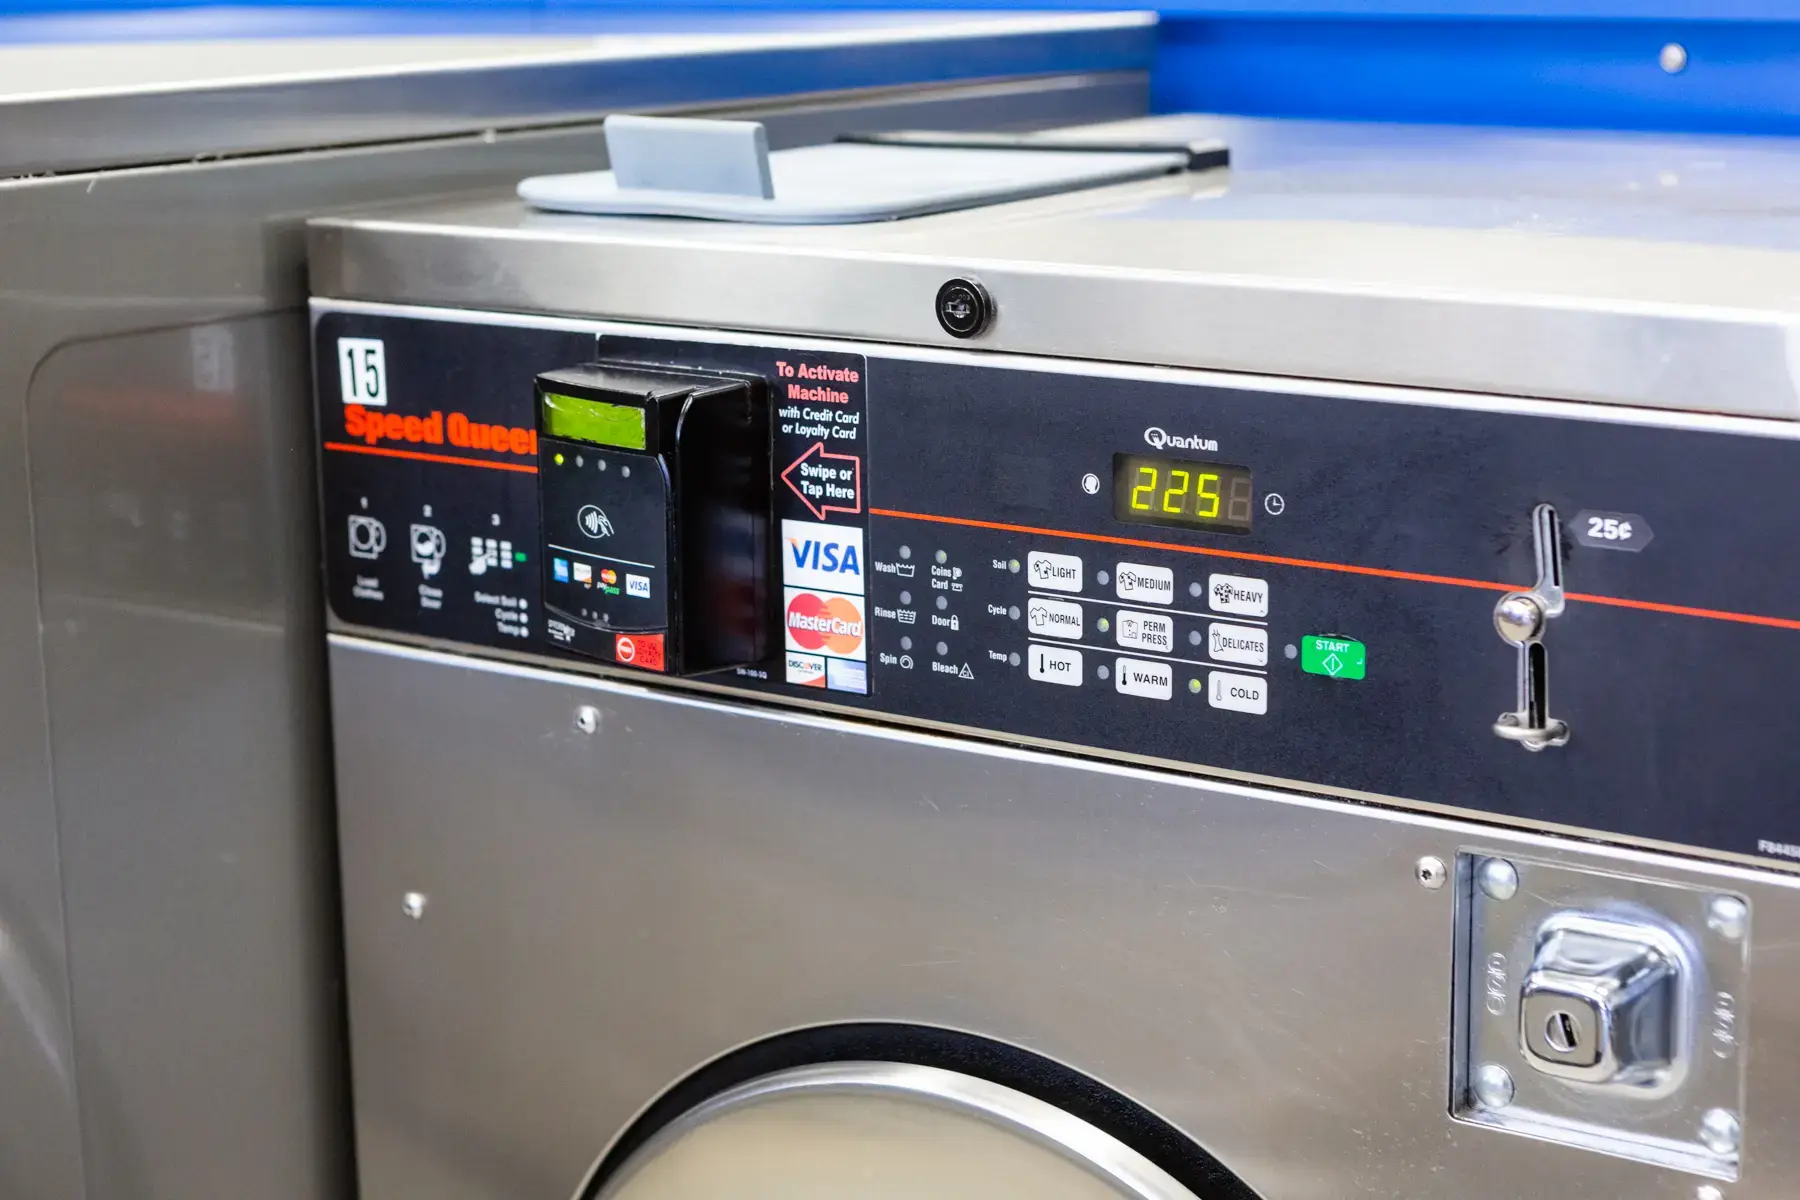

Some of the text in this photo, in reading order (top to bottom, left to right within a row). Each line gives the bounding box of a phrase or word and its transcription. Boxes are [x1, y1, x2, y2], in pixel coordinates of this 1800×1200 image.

[347, 348, 379, 398] 15
[776, 361, 860, 383] To Activate
[788, 384, 849, 404] Machine
[778, 406, 860, 425] with Credit Card
[344, 403, 444, 444] Speed
[782, 422, 857, 440] or Loyalty Card
[1144, 427, 1218, 451] Quantum
[800, 463, 853, 481] Swipe or
[800, 481, 855, 499] Tap Here
[1131, 467, 1220, 518] 225
[491, 513, 501, 526] 3
[1587, 517, 1632, 540] 25¢
[787, 537, 861, 576] VISA
[875, 561, 897, 574] Wash
[931, 565, 952, 578] Coins
[992, 559, 1007, 570] Soil
[1052, 567, 1076, 580] LIGHT
[629, 580, 649, 593] VISA
[931, 578, 949, 590] Card
[1137, 579, 1171, 592] MEDIUM
[1233, 590, 1264, 604] HEAVY
[875, 606, 896, 619] Rinse
[988, 604, 1007, 616] Cycle
[788, 611, 862, 637] MasterCard
[932, 615, 951, 627] Door
[1049, 613, 1081, 627] NORMAL
[1143, 620, 1166, 633] PERM
[1141, 632, 1168, 646] PRESS
[1222, 637, 1265, 653] DELICATES
[1315, 640, 1350, 653] START
[880, 653, 897, 665] Spin
[988, 650, 1007, 663] Temp
[788, 660, 823, 671] DISCOVER
[932, 661, 958, 675] Bleach
[1050, 660, 1071, 672] HOT
[1133, 672, 1168, 687] WARM
[1230, 687, 1260, 701] COLD
